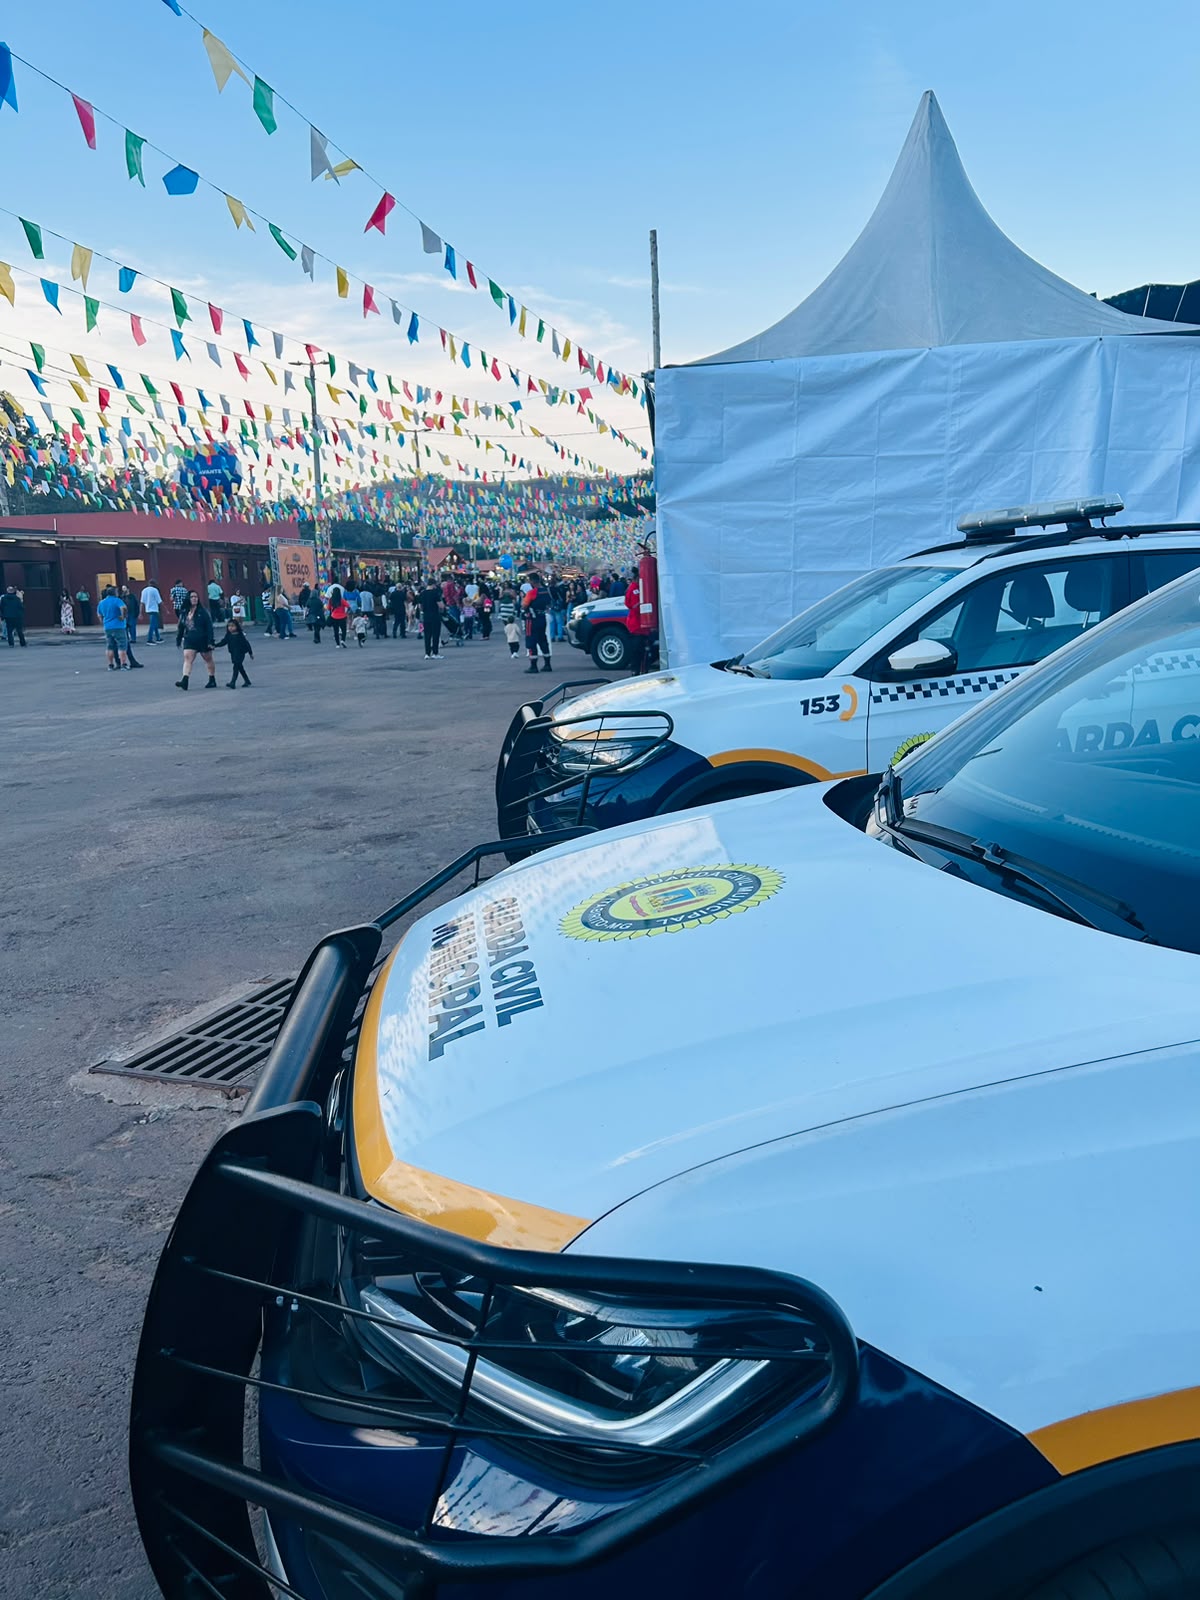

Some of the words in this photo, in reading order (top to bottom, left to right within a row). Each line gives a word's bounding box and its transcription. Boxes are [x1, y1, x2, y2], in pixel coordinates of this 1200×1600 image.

[286, 563, 309, 576] ESPAÇO
[800, 694, 840, 717] 153
[1056, 719, 1161, 753] ARDA
[635, 871, 721, 890] GUARDA
[656, 885, 755, 925] MUNICIPAL
[482, 897, 530, 968] GUARDA
[428, 912, 486, 1062] MUNICIPAL
[490, 960, 544, 1028] CIVIL
